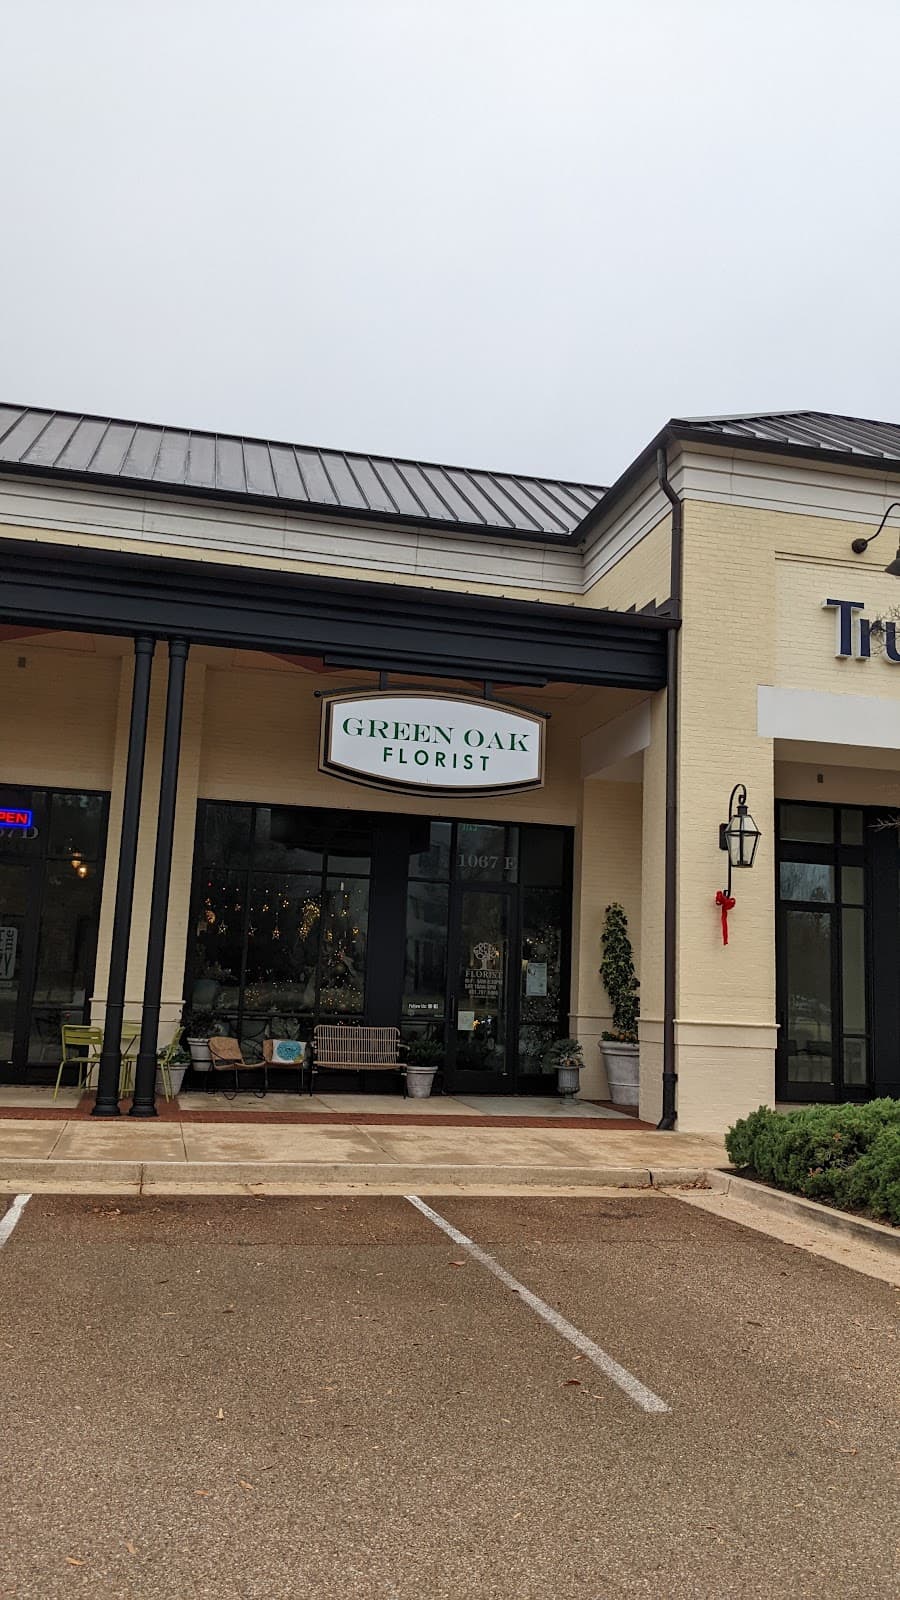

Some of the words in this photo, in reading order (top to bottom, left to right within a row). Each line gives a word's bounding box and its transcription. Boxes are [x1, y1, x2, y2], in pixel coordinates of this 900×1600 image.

[342, 717, 455, 745] GREEN
[464, 728, 530, 752] OAK
[383, 746, 490, 771] FLORIST
[456, 854, 499, 869] 1067
[504, 856, 518, 870] E
[465, 970, 503, 979] FLORIST
